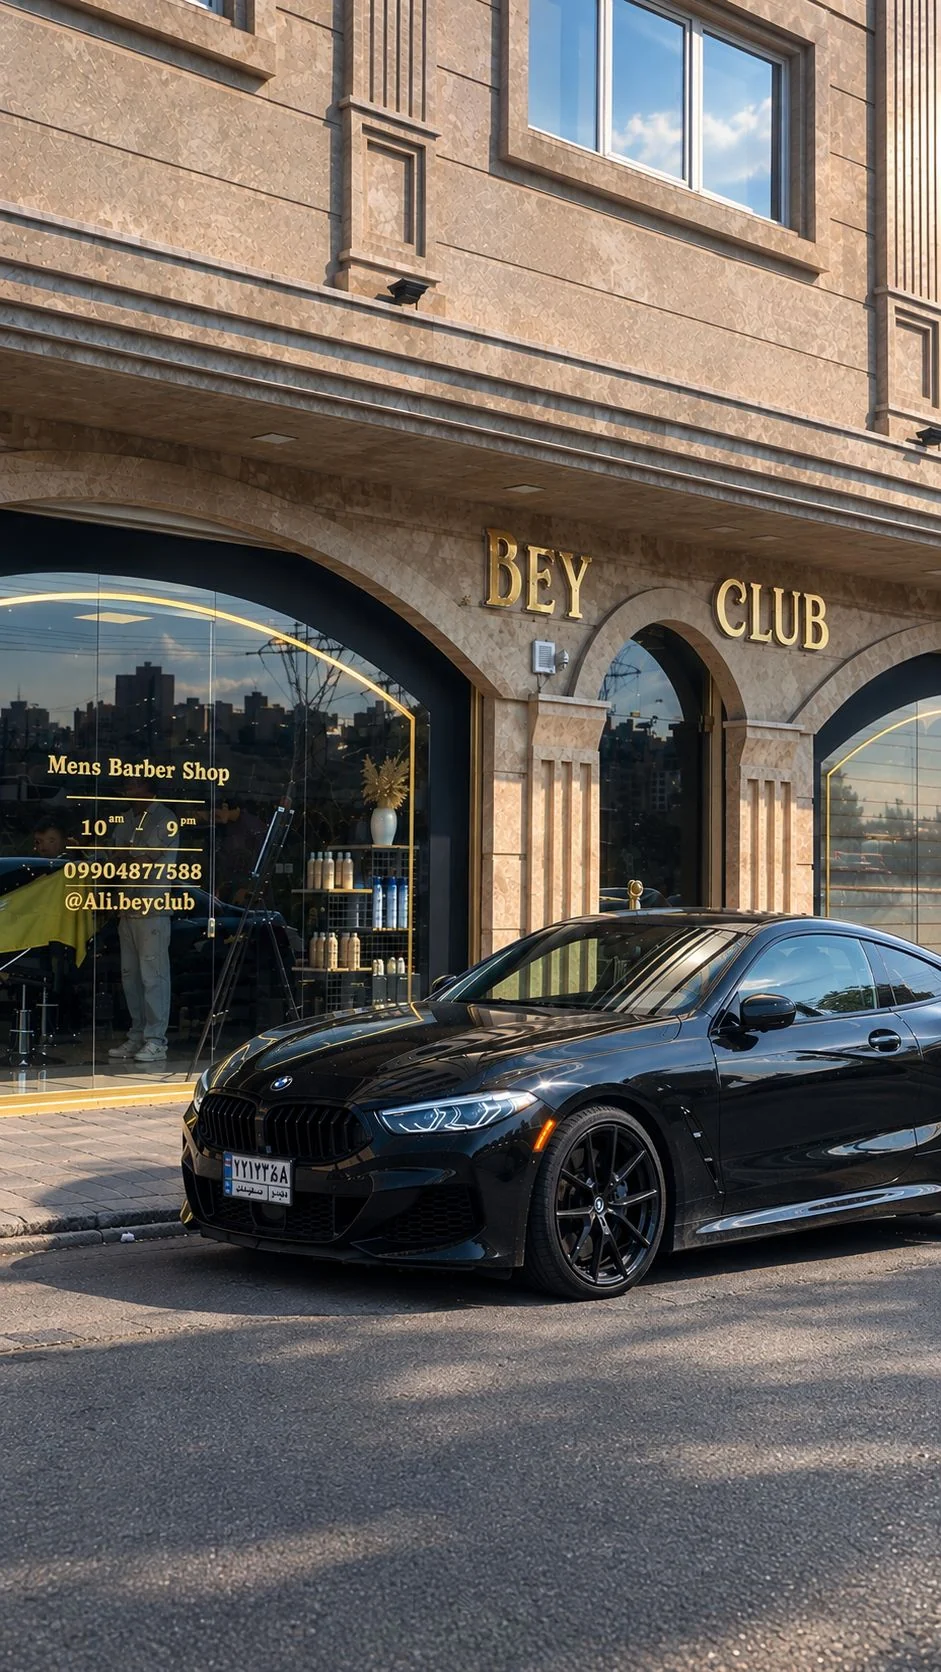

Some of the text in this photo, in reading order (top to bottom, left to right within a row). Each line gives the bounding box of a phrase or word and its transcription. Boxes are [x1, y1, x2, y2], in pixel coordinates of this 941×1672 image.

[484, 527, 830, 651] BEY CLUB
[47, 754, 230, 786] Mens Barber Shop
[63, 862, 202, 880] 09904877588
[64, 891, 195, 915] @Ali.beyclub
